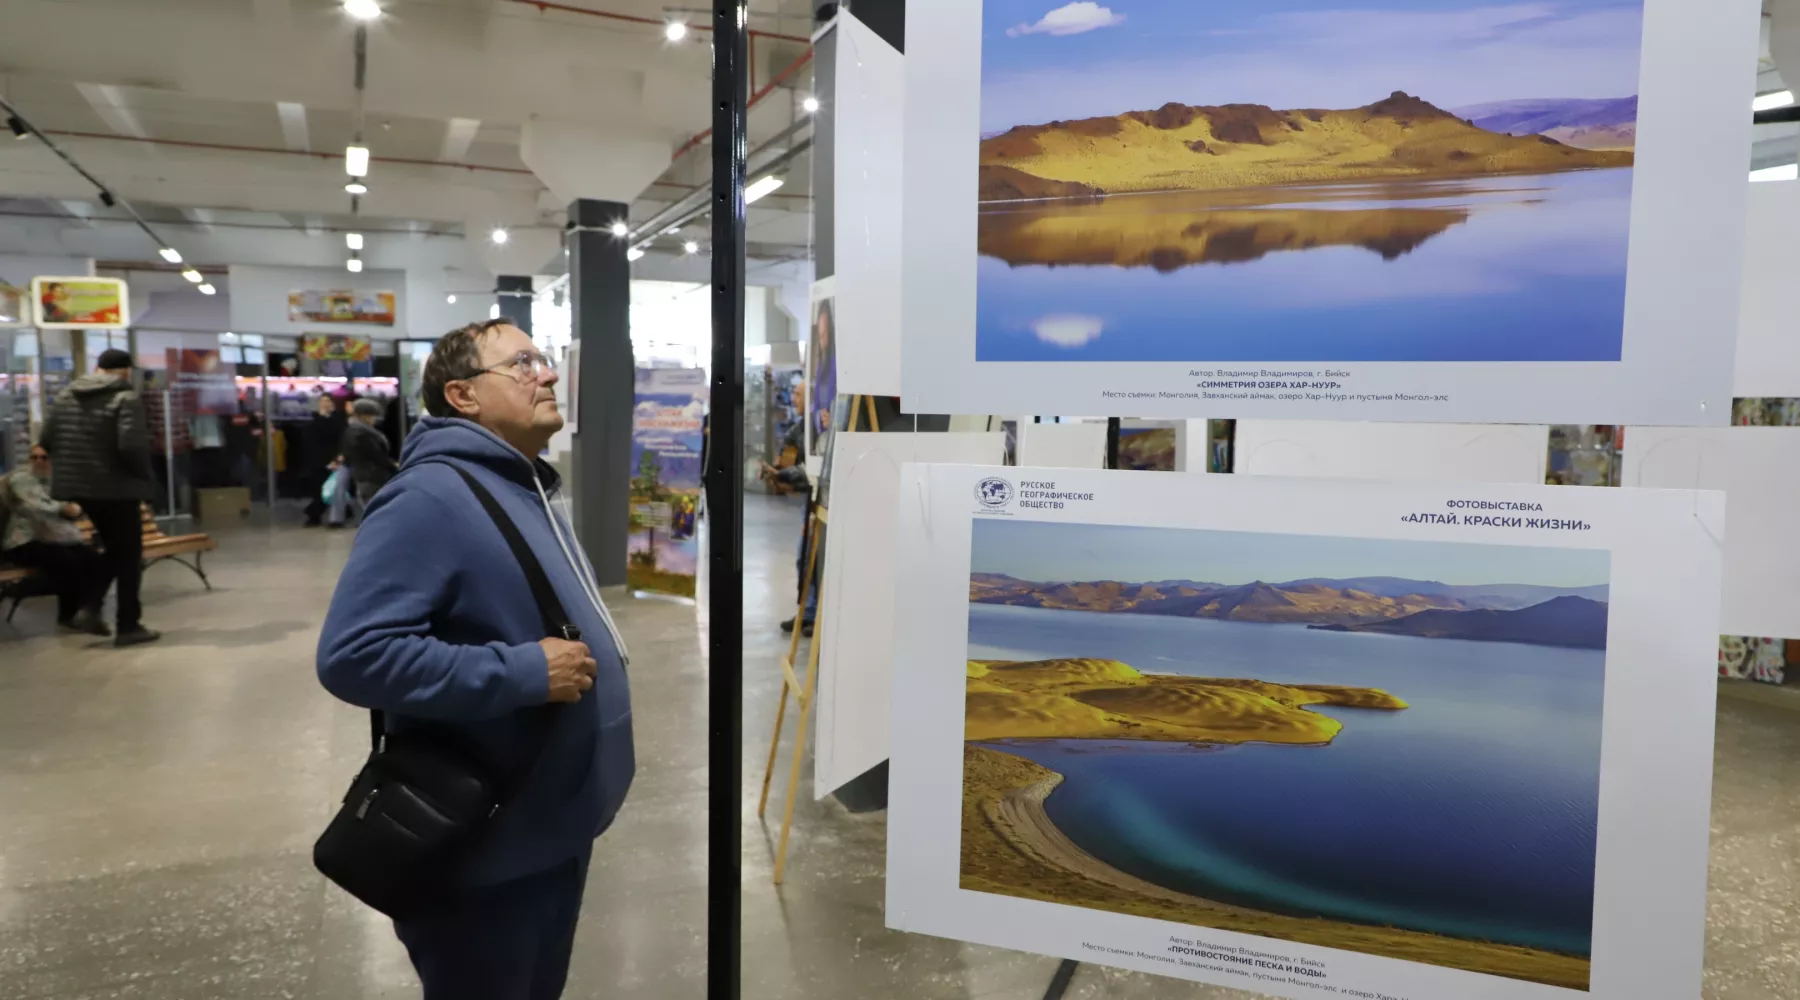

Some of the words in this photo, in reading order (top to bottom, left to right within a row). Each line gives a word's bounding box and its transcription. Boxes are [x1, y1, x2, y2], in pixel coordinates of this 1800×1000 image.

[1217, 370, 1258, 379] Владимир
[1261, 370, 1315, 379] Владимиров,
[1197, 381, 1256, 389] «СИММЕТРИЯ
[1258, 381, 1288, 389] ОЗЕРА
[1159, 391, 1199, 399] Монголия,
[1250, 392, 1276, 400] аймак,
[1305, 392, 1347, 401] Хар-Нуур
[1395, 394, 1449, 402] Монгол-элс
[1020, 481, 1056, 490] РУССКОЕ
[1020, 491, 1094, 500] ГЕОГРАФИЧЕСКОЕ
[1019, 501, 1064, 509] ОБЩЕСТВО
[1446, 500, 1543, 511] ФОТОВЫСТАВКА
[1400, 513, 1460, 525] «АЛТАЙ.
[1464, 516, 1522, 527] КРАСКИ
[1525, 518, 1591, 531] ЖИЗНИ»
[1196, 940, 1237, 953] Владимир
[1238, 947, 1291, 962] Владимиров,
[1300, 957, 1326, 967] Бийск
[1167, 946, 1254, 966] «ПРОТИВОСТОЯНИЕ
[1254, 960, 1285, 971] ПЕСКА
[1294, 966, 1328, 978] ВОДЫ»
[1082, 942, 1106, 952] Место
[1106, 947, 1136, 957] съемки:
[1136, 951, 1177, 964] Монголия,
[1179, 958, 1224, 972] Завханский
[1225, 968, 1251, 978] аймак,
[1252, 971, 1287, 984] пустыня
[1287, 977, 1338, 993] Монгол-элс
[1348, 989, 1375, 999] озеро
